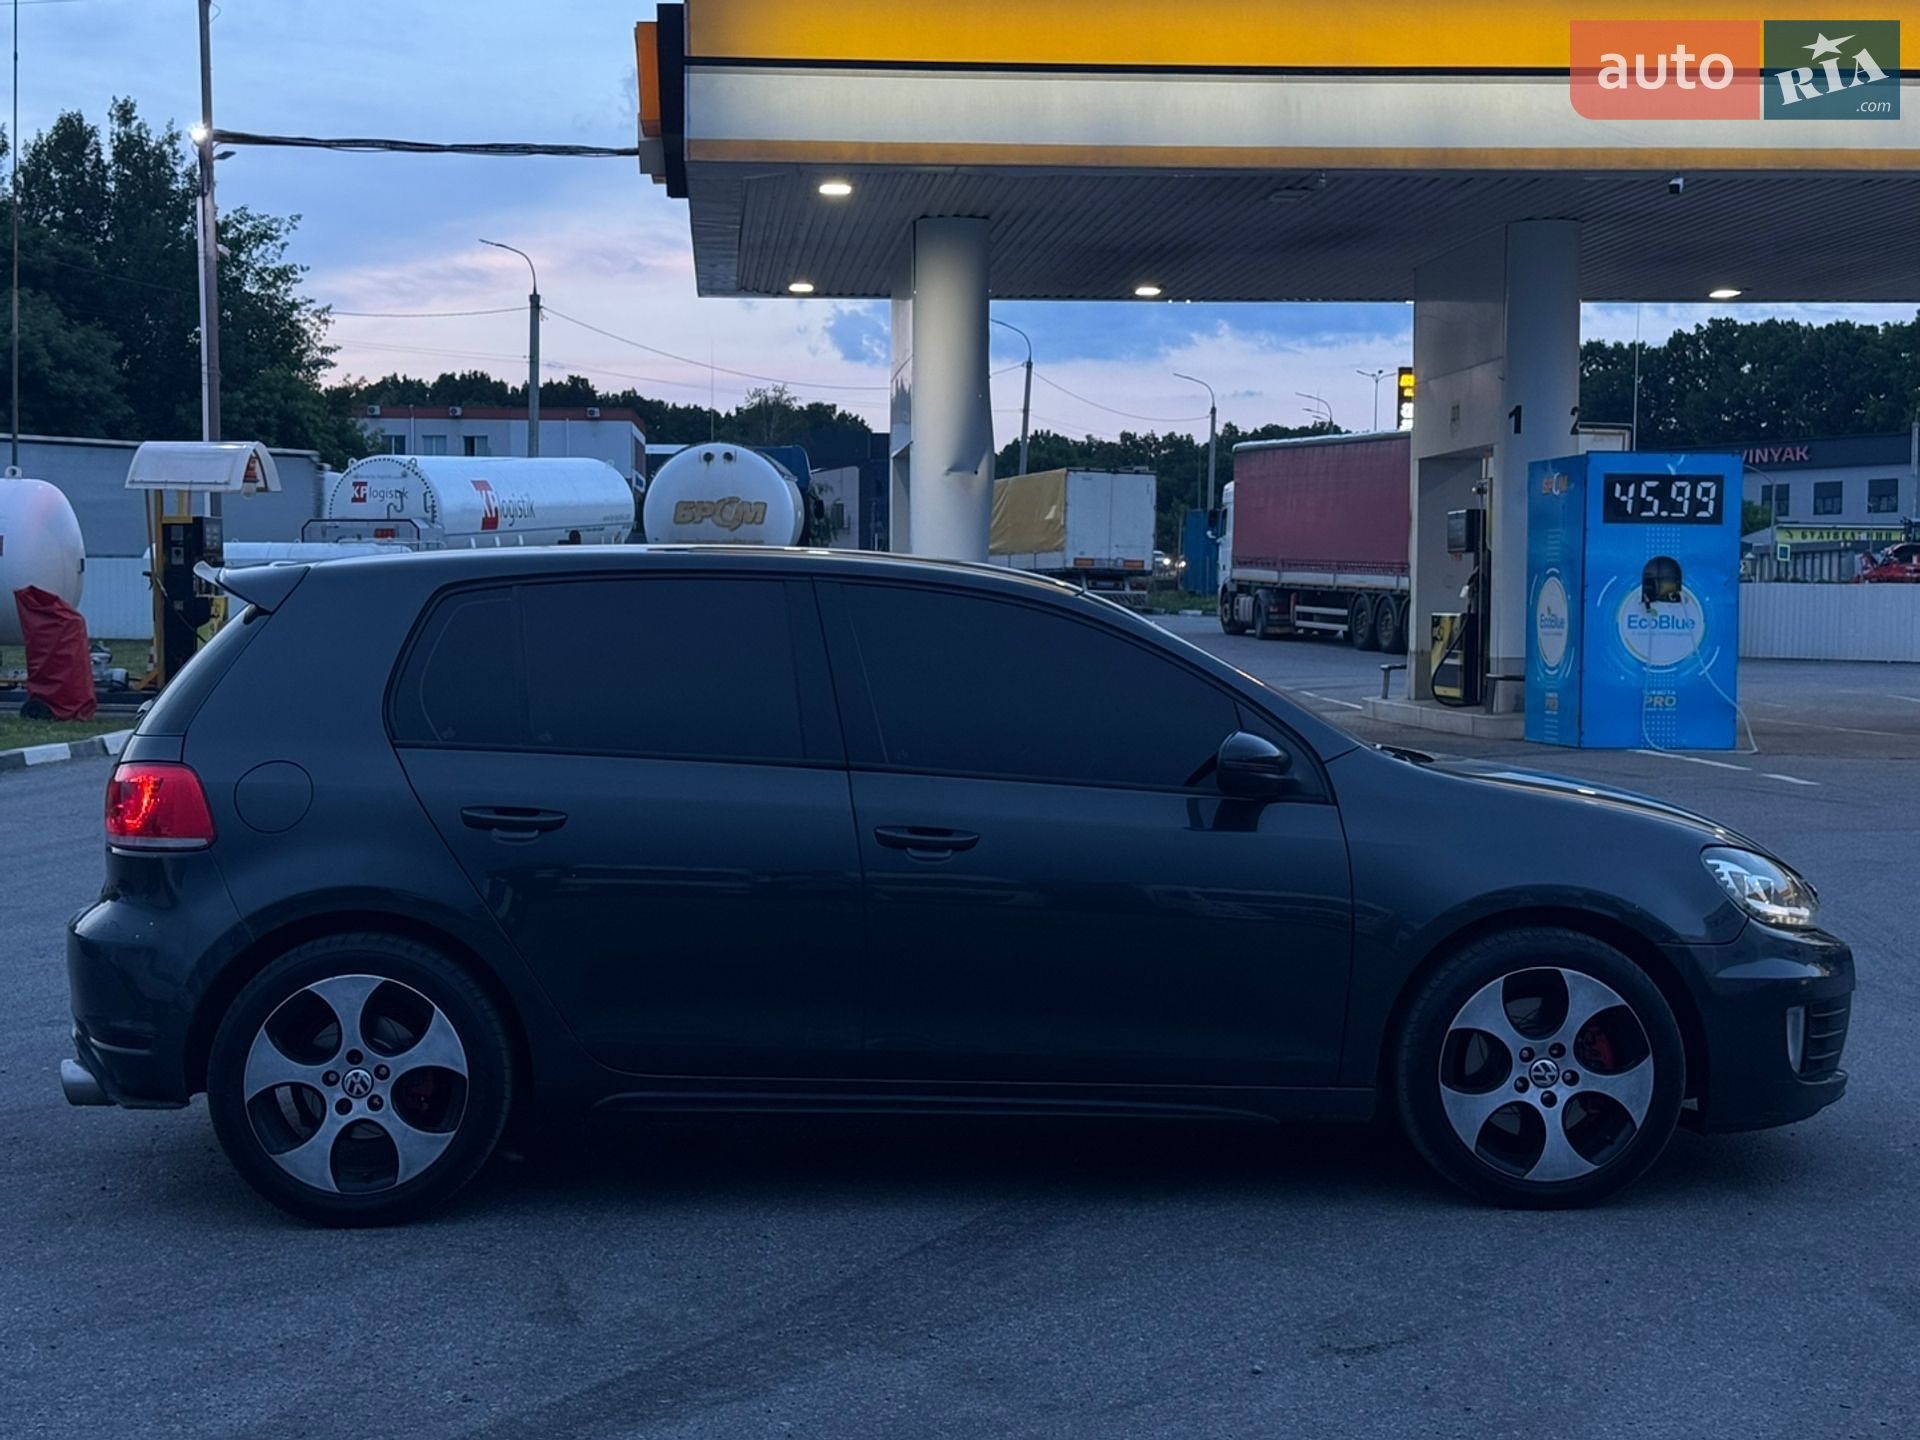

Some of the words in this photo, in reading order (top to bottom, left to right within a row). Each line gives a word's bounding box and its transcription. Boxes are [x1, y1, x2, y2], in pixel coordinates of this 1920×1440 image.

[1508, 404, 1522, 434] 1
[1614, 480, 1716, 518] 45.99
[1627, 614, 1696, 630] EcoBlue
[1644, 695, 1677, 708] PRO
